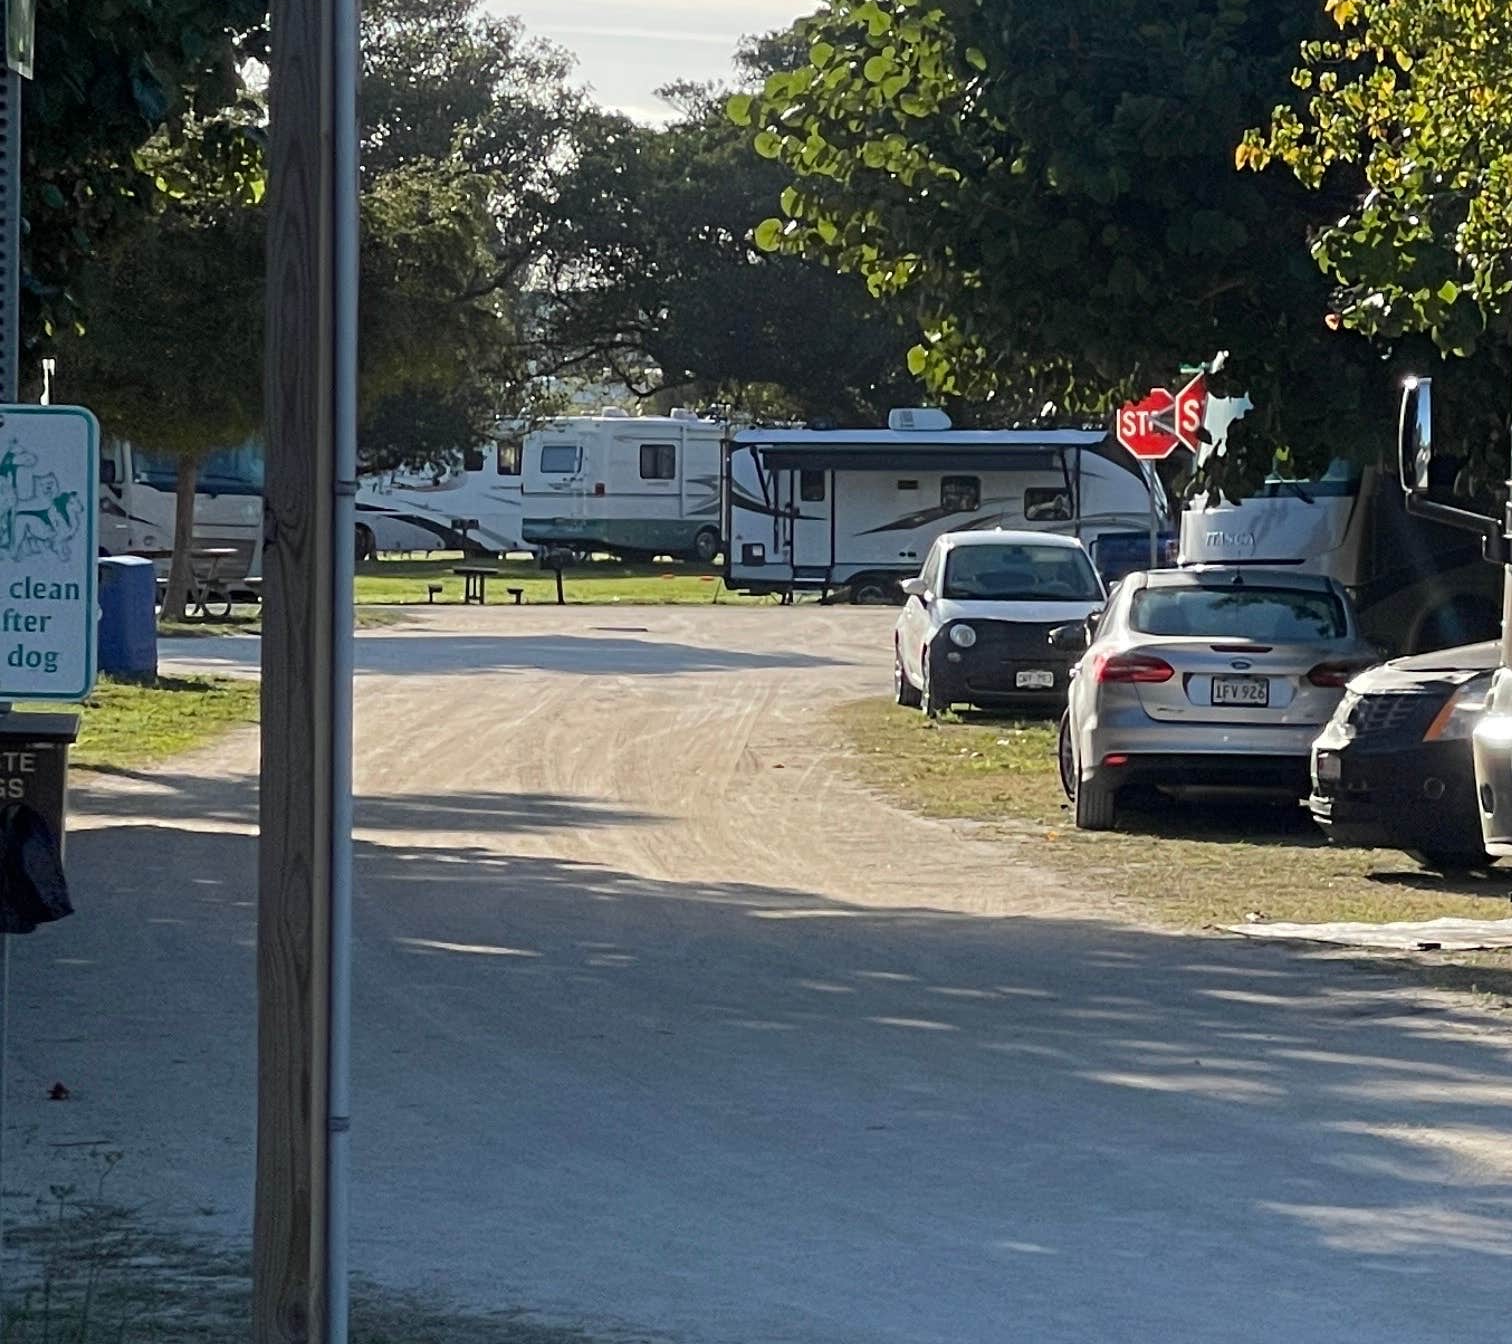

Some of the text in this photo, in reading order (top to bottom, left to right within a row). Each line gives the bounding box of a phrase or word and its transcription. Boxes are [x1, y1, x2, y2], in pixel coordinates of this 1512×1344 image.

[8, 575, 80, 601] clean
[2, 607, 52, 633] fter
[7, 643, 60, 673] dog
[1241, 685, 1266, 700] 926
[2, 751, 37, 772] TE
